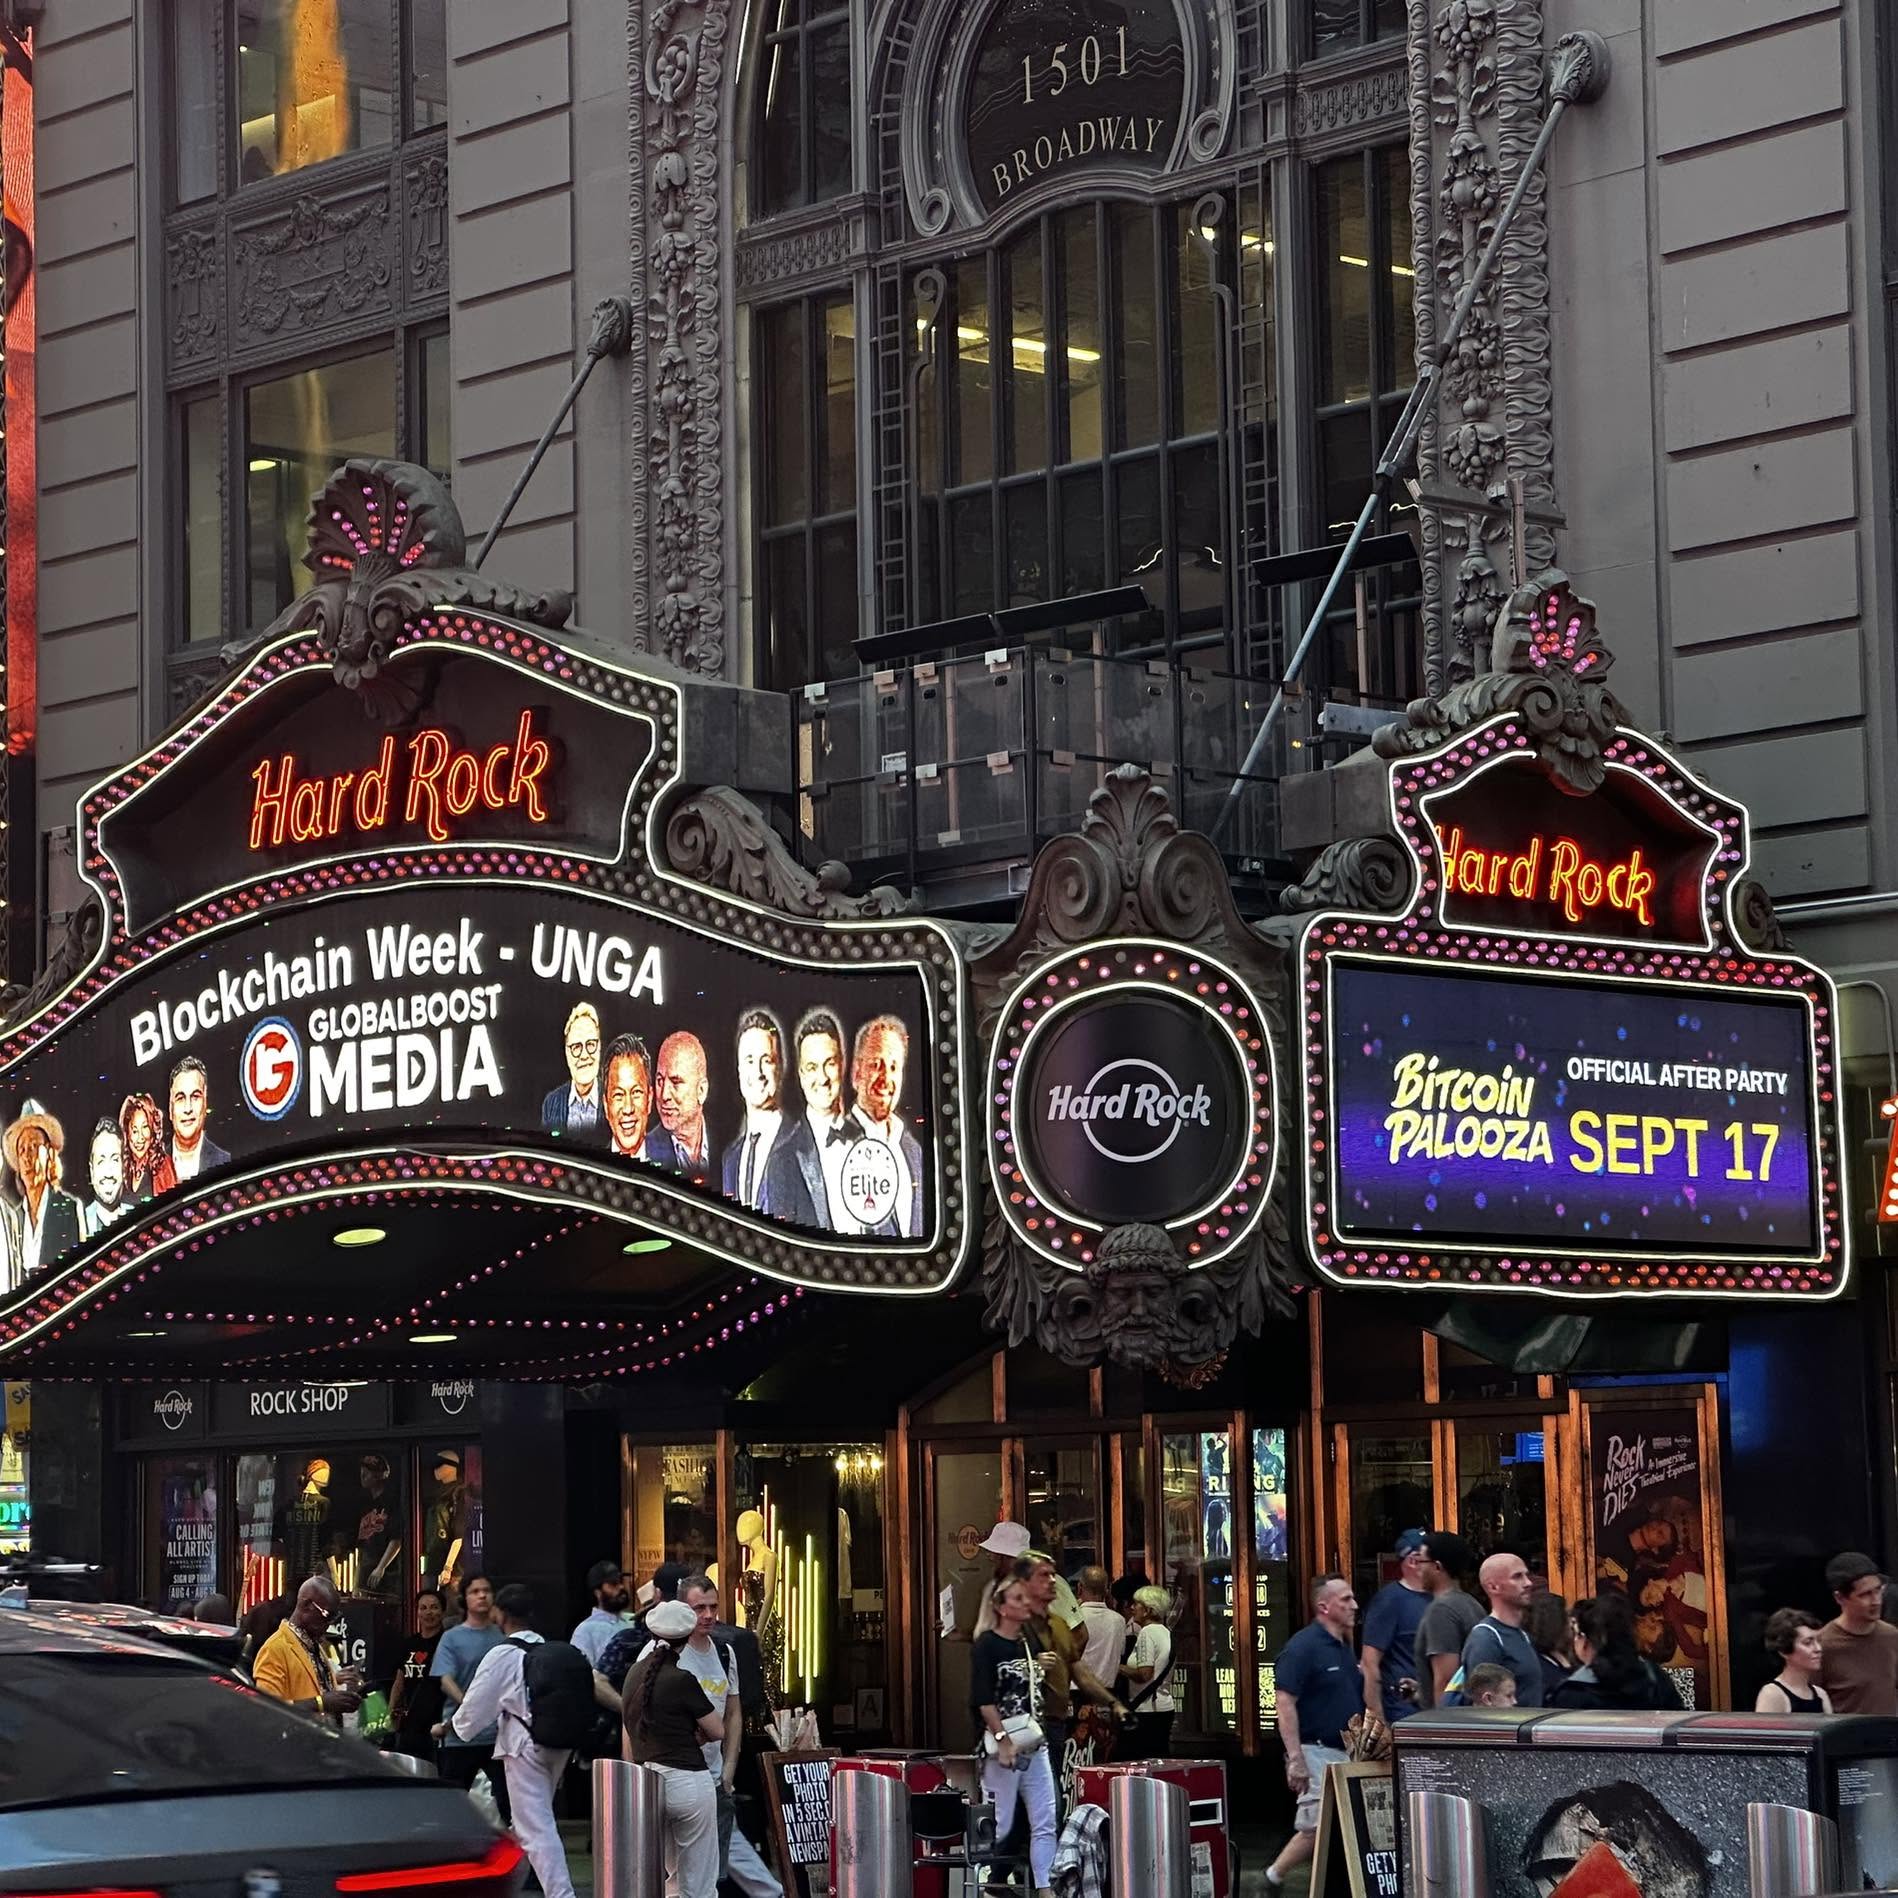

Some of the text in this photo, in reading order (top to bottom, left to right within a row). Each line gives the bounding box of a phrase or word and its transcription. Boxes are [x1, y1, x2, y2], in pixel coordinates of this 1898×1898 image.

[1022, 26, 1129, 104] 1501
[992, 116, 1164, 198] BROADWAY
[250, 709, 549, 850] Hard Rock
[1435, 825, 1652, 926] Hard Rock
[130, 936, 352, 1066] Blockchain
[367, 917, 486, 980] Week
[531, 921, 664, 1006] UNGA
[308, 984, 503, 1042] GLOBALBOOST
[308, 1024, 504, 1118] MEDIA
[1567, 1057, 1789, 1096] OFFICIAL AFTER PARTY
[1048, 1083, 1212, 1127] Hard Rock
[1383, 1110, 1555, 1165] PALOOZA
[1568, 1109, 1781, 1182] SEPT 17
[851, 1174, 890, 1200] Elite
[250, 1387, 349, 1416] ROCK SHOP
[432, 1381, 474, 1398] Hard Rock
[154, 1398, 192, 1414] Hard Rock
[1603, 1472, 1640, 1527] DIES
[176, 1524, 213, 1541] CALLING
[167, 1541, 183, 1558] ALL
[171, 1587, 184, 1599] AUG
[404, 1664, 426, 1679] NY
[406, 1652, 416, 1664] I
[784, 1761, 829, 1784] GET YOUR
[793, 1781, 827, 1803] PHOTO
[782, 1804, 795, 1824] IN
[796, 1802, 804, 1822] 5
[786, 1823, 795, 1843] A
[1366, 1851, 1388, 1875] GET
